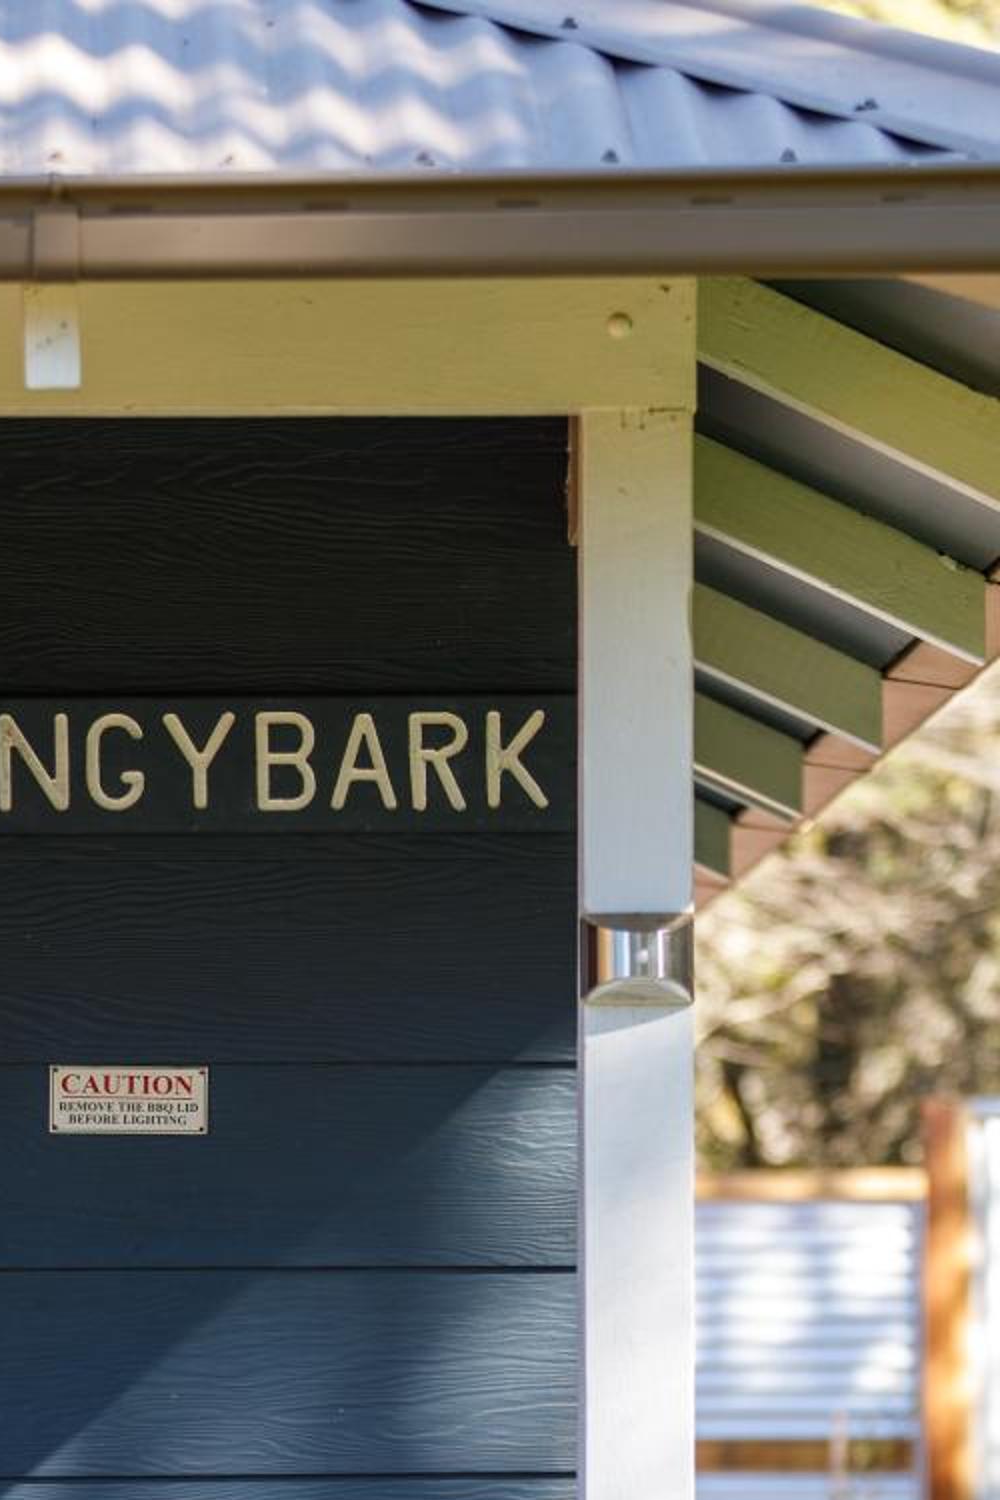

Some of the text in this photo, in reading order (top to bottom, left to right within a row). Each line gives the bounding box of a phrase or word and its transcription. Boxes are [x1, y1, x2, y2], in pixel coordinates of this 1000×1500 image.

[61, 1073, 193, 1095] CAUTION
[59, 1102, 199, 1114] REMOVE THE BBQ LID
[69, 1114, 187, 1125] BEFORE LIGHTING
